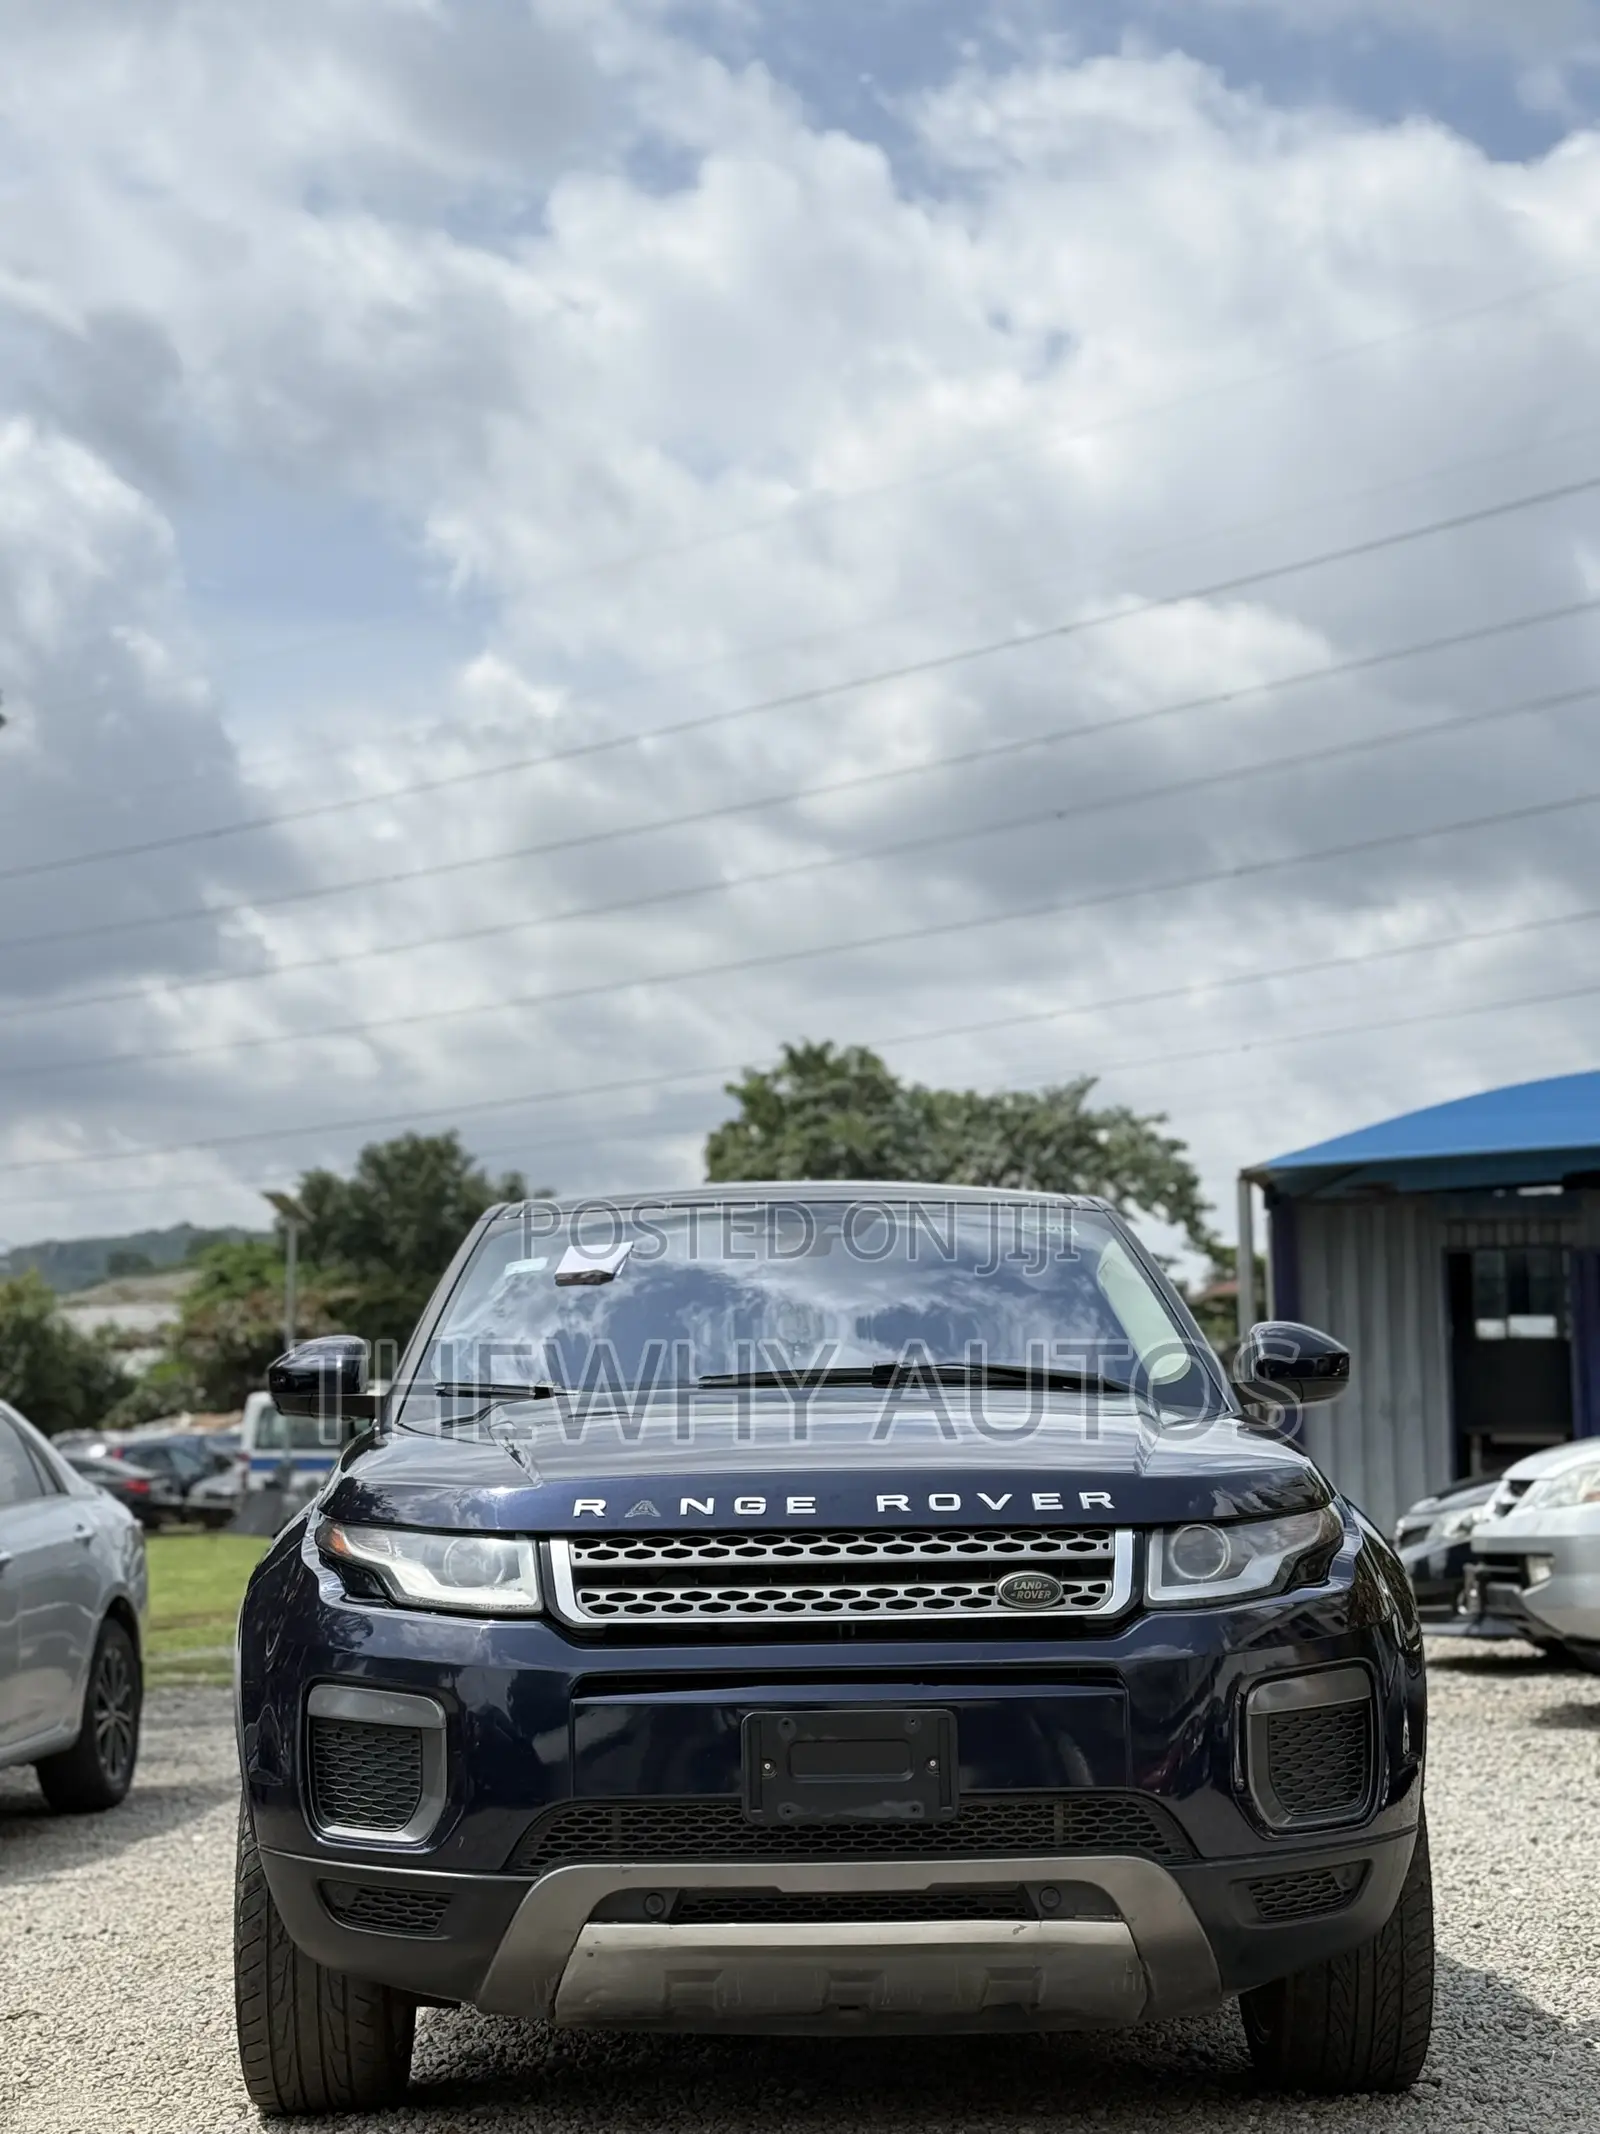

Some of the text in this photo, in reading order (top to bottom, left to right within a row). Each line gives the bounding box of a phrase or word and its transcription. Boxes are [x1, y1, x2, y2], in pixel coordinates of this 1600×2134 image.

[573, 1491, 1116, 1518] RANGE ROVER
[1013, 1581, 1042, 1590] LAND
[1016, 1590, 1052, 1600] ROVER
